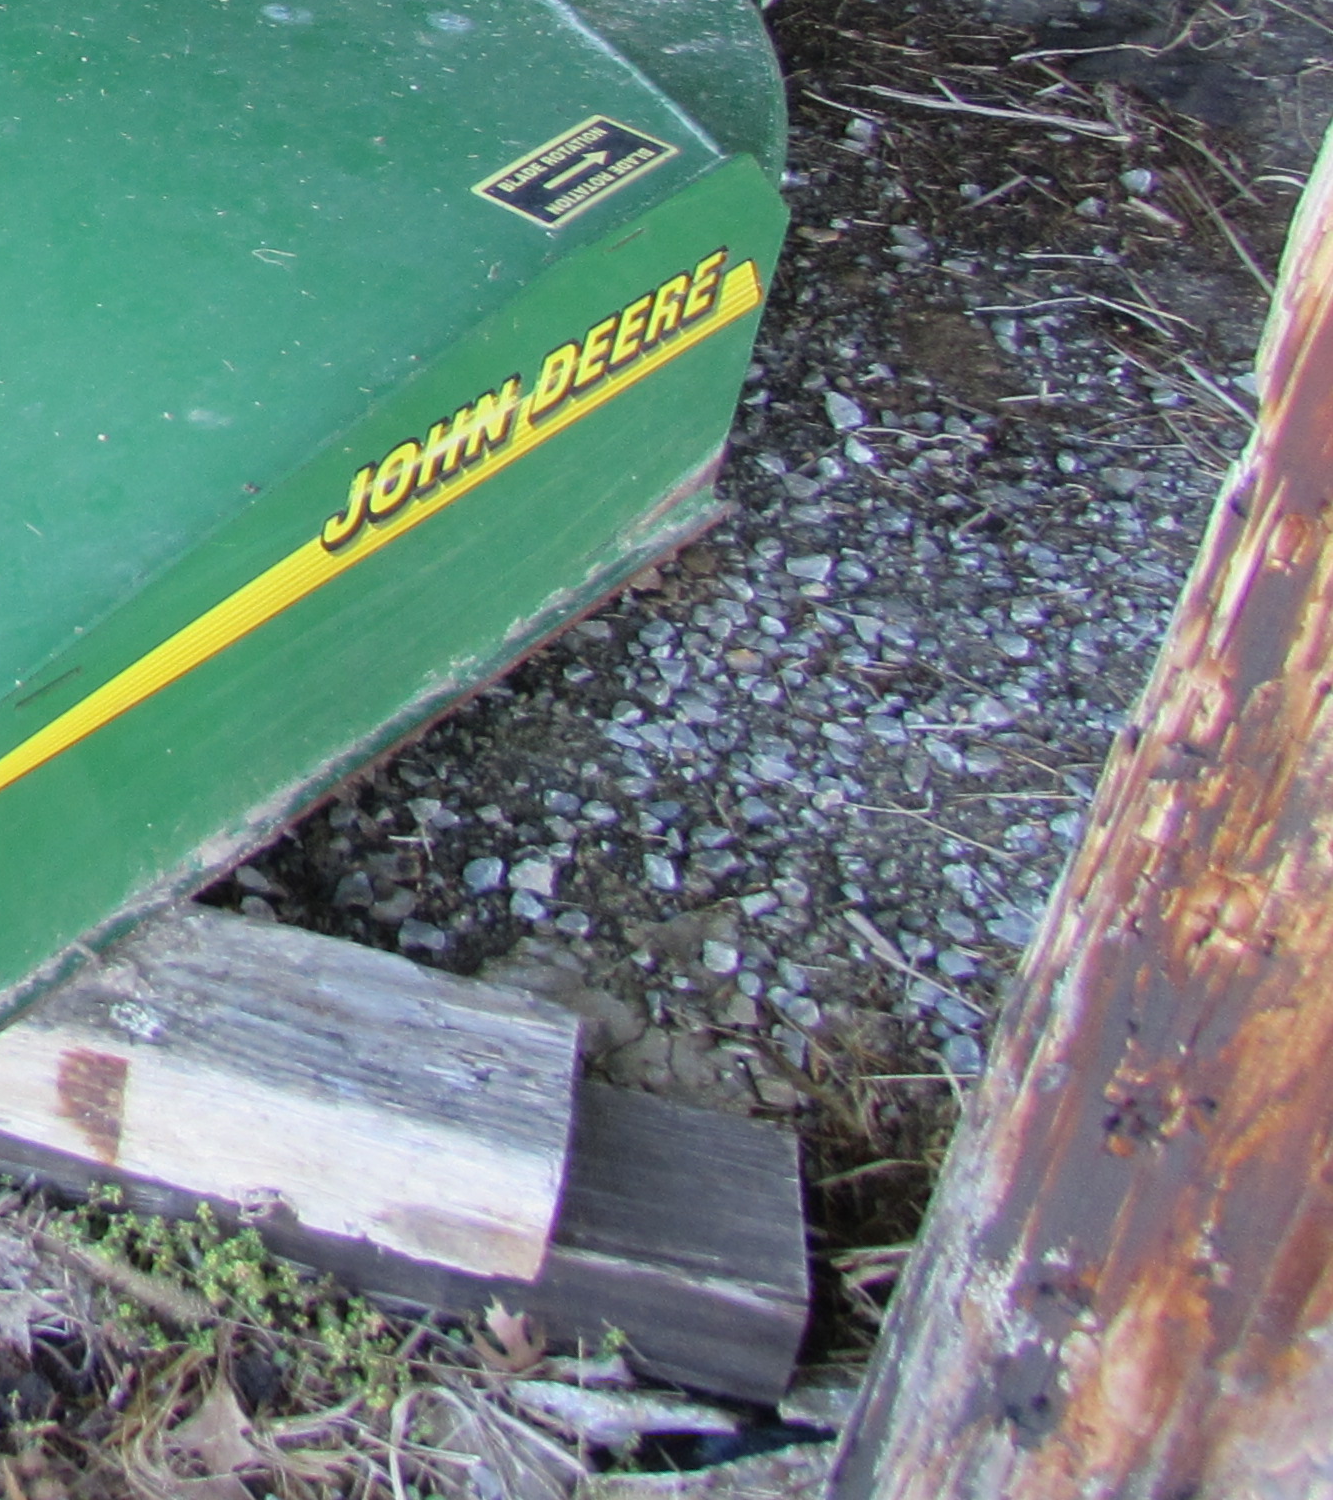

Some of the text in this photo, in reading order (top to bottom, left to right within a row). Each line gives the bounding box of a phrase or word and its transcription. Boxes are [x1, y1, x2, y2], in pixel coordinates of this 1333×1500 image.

[498, 127, 608, 193] BLADE ROTATION
[545, 147, 656, 215] BLADE ROTATION
[321, 245, 729, 552] JOHN DEERE
